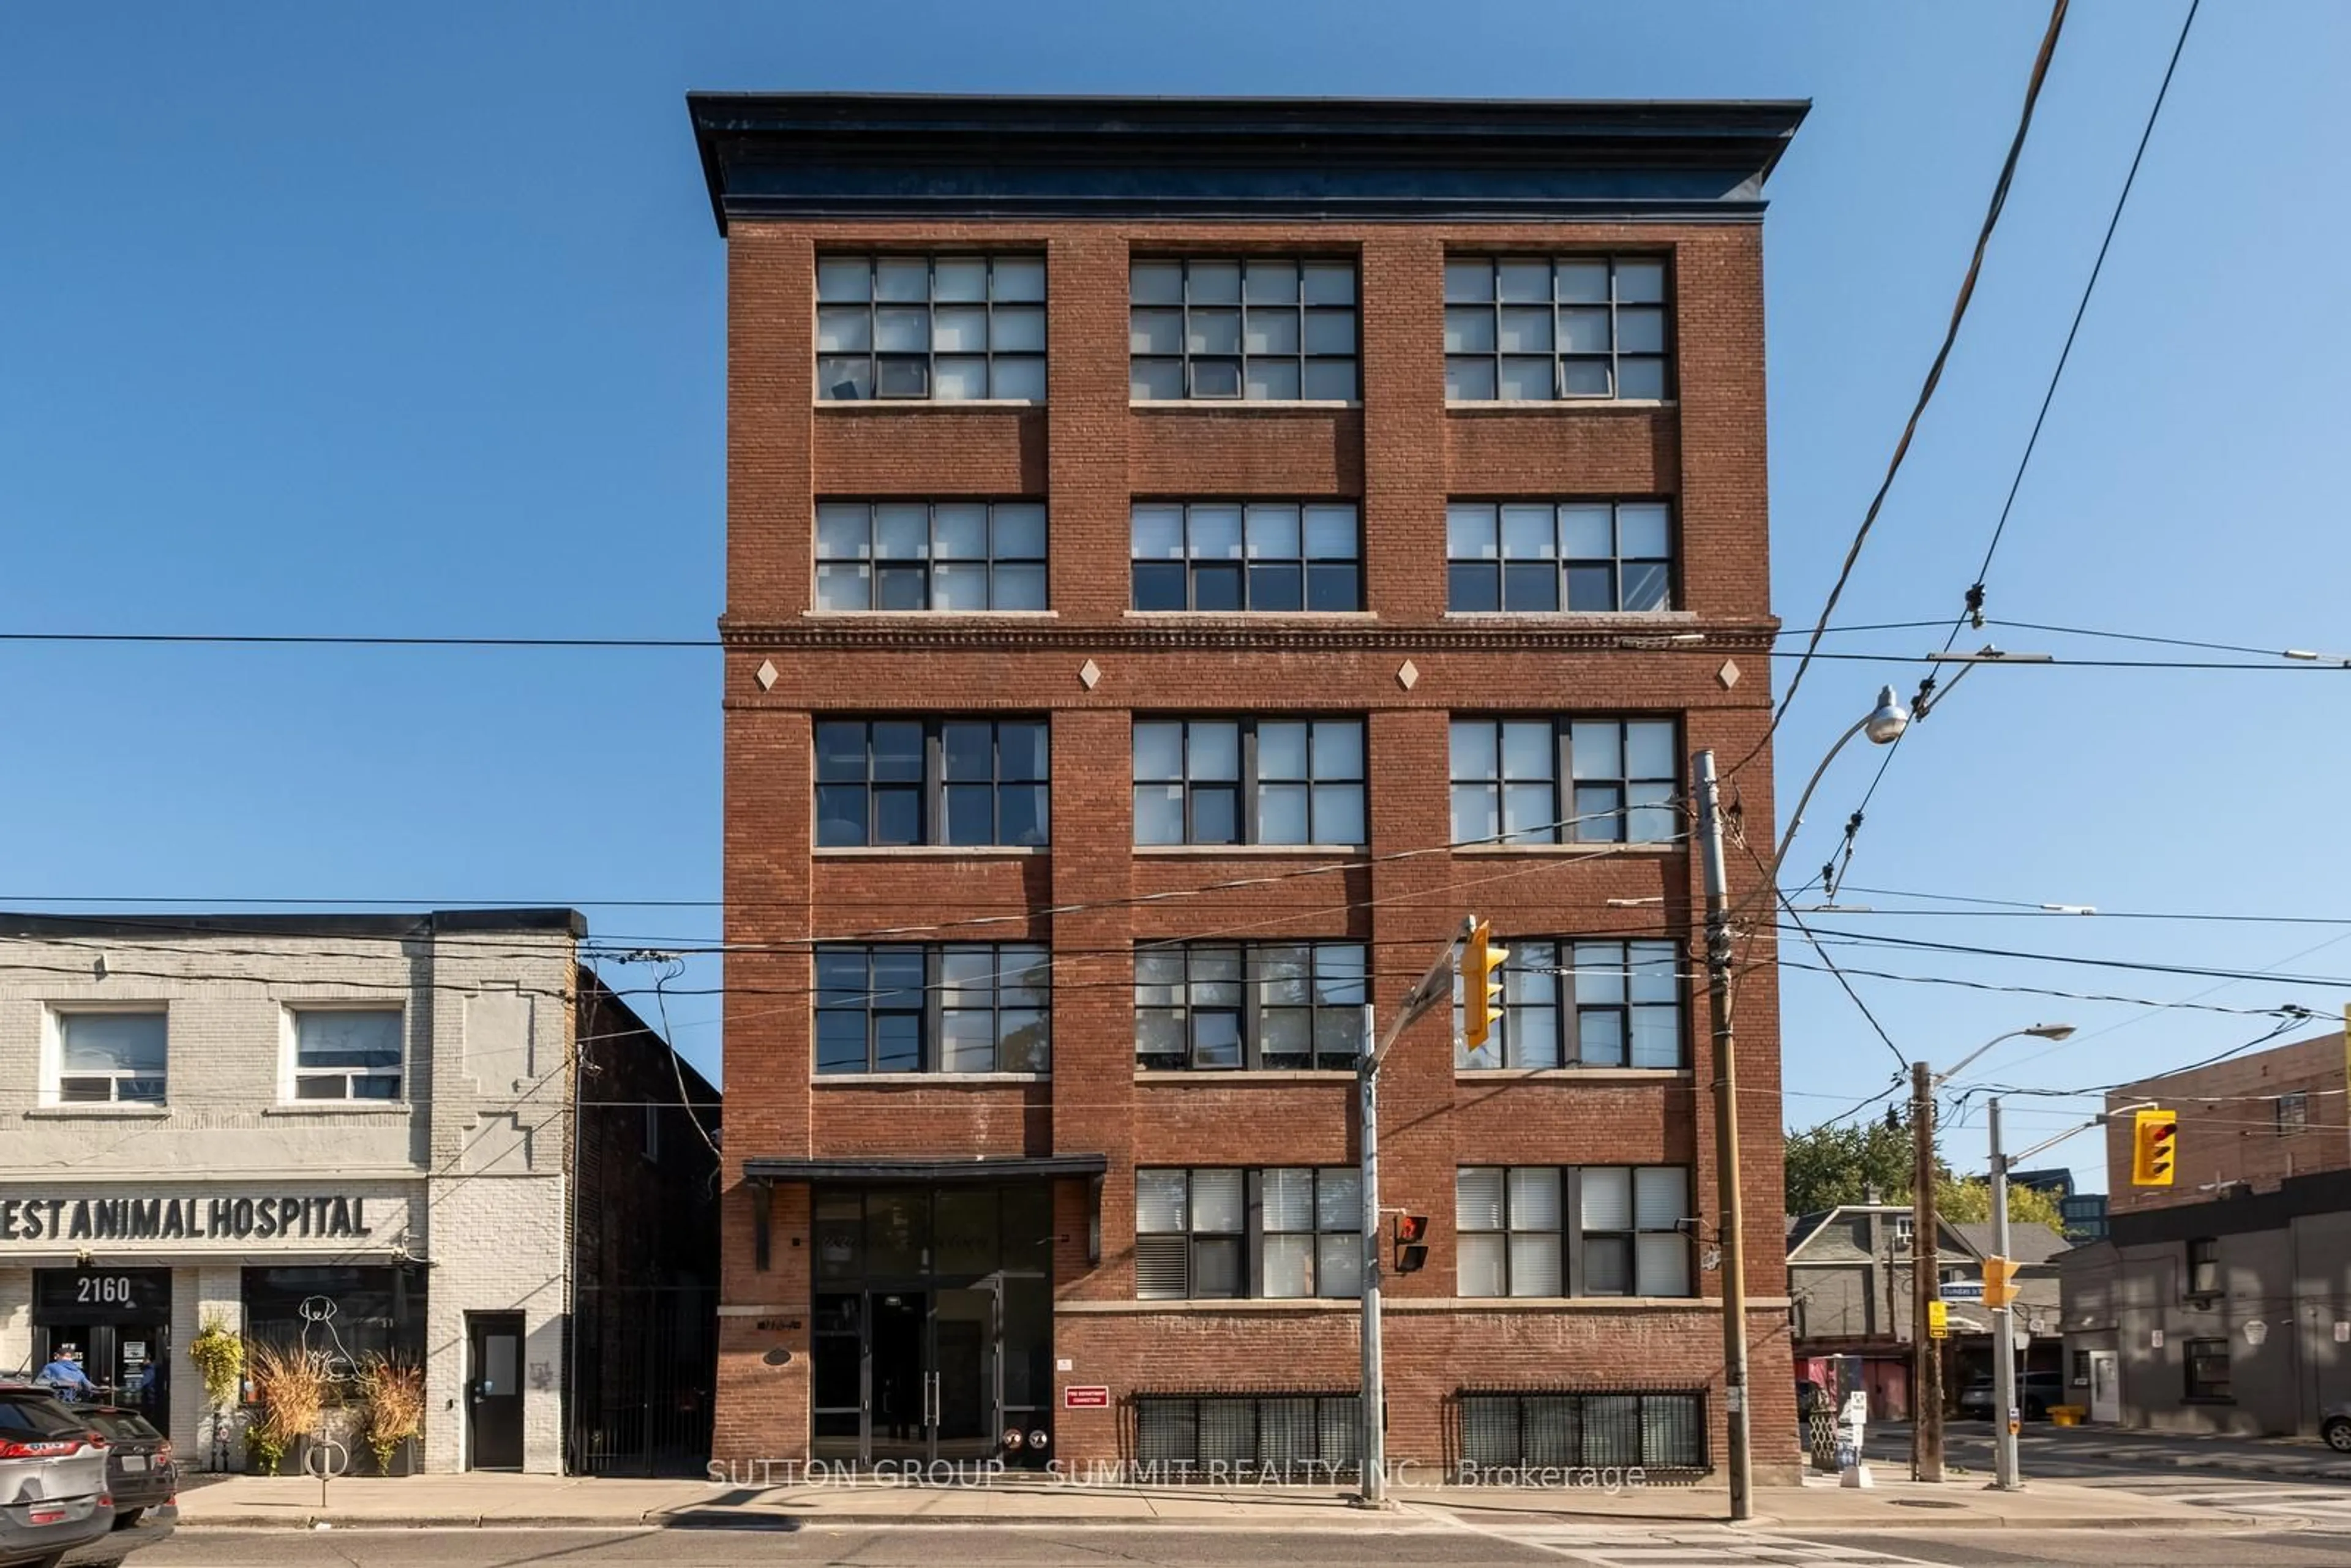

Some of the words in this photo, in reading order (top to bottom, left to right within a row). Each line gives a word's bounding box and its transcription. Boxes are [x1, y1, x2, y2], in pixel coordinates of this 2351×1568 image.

[67, 1198, 204, 1240] ANIMAL
[207, 1196, 372, 1239] HOSPITAL
[77, 1277, 130, 1302] 2160
